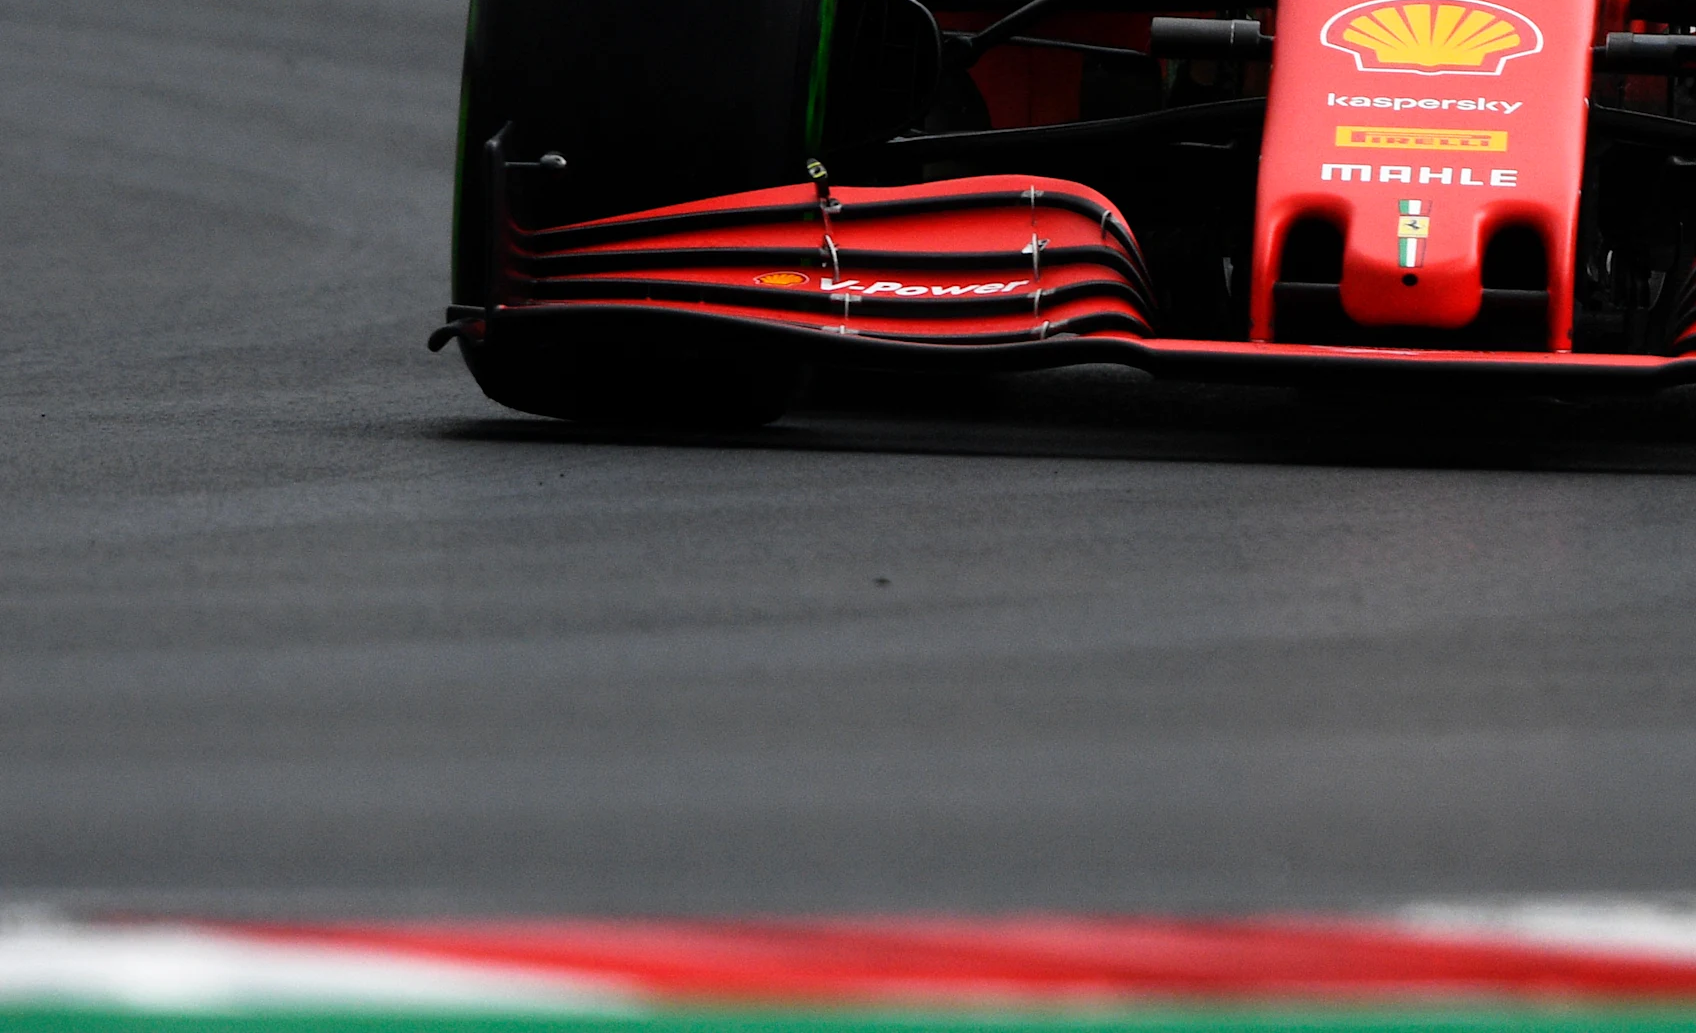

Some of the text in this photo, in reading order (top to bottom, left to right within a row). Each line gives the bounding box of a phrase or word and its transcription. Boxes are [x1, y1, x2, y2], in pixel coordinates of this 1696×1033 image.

[1327, 92, 1523, 114] kaspersky
[1350, 130, 1492, 147] PIRELLI
[1320, 163, 1518, 187] MAHLE
[820, 277, 1030, 296] V-Power
